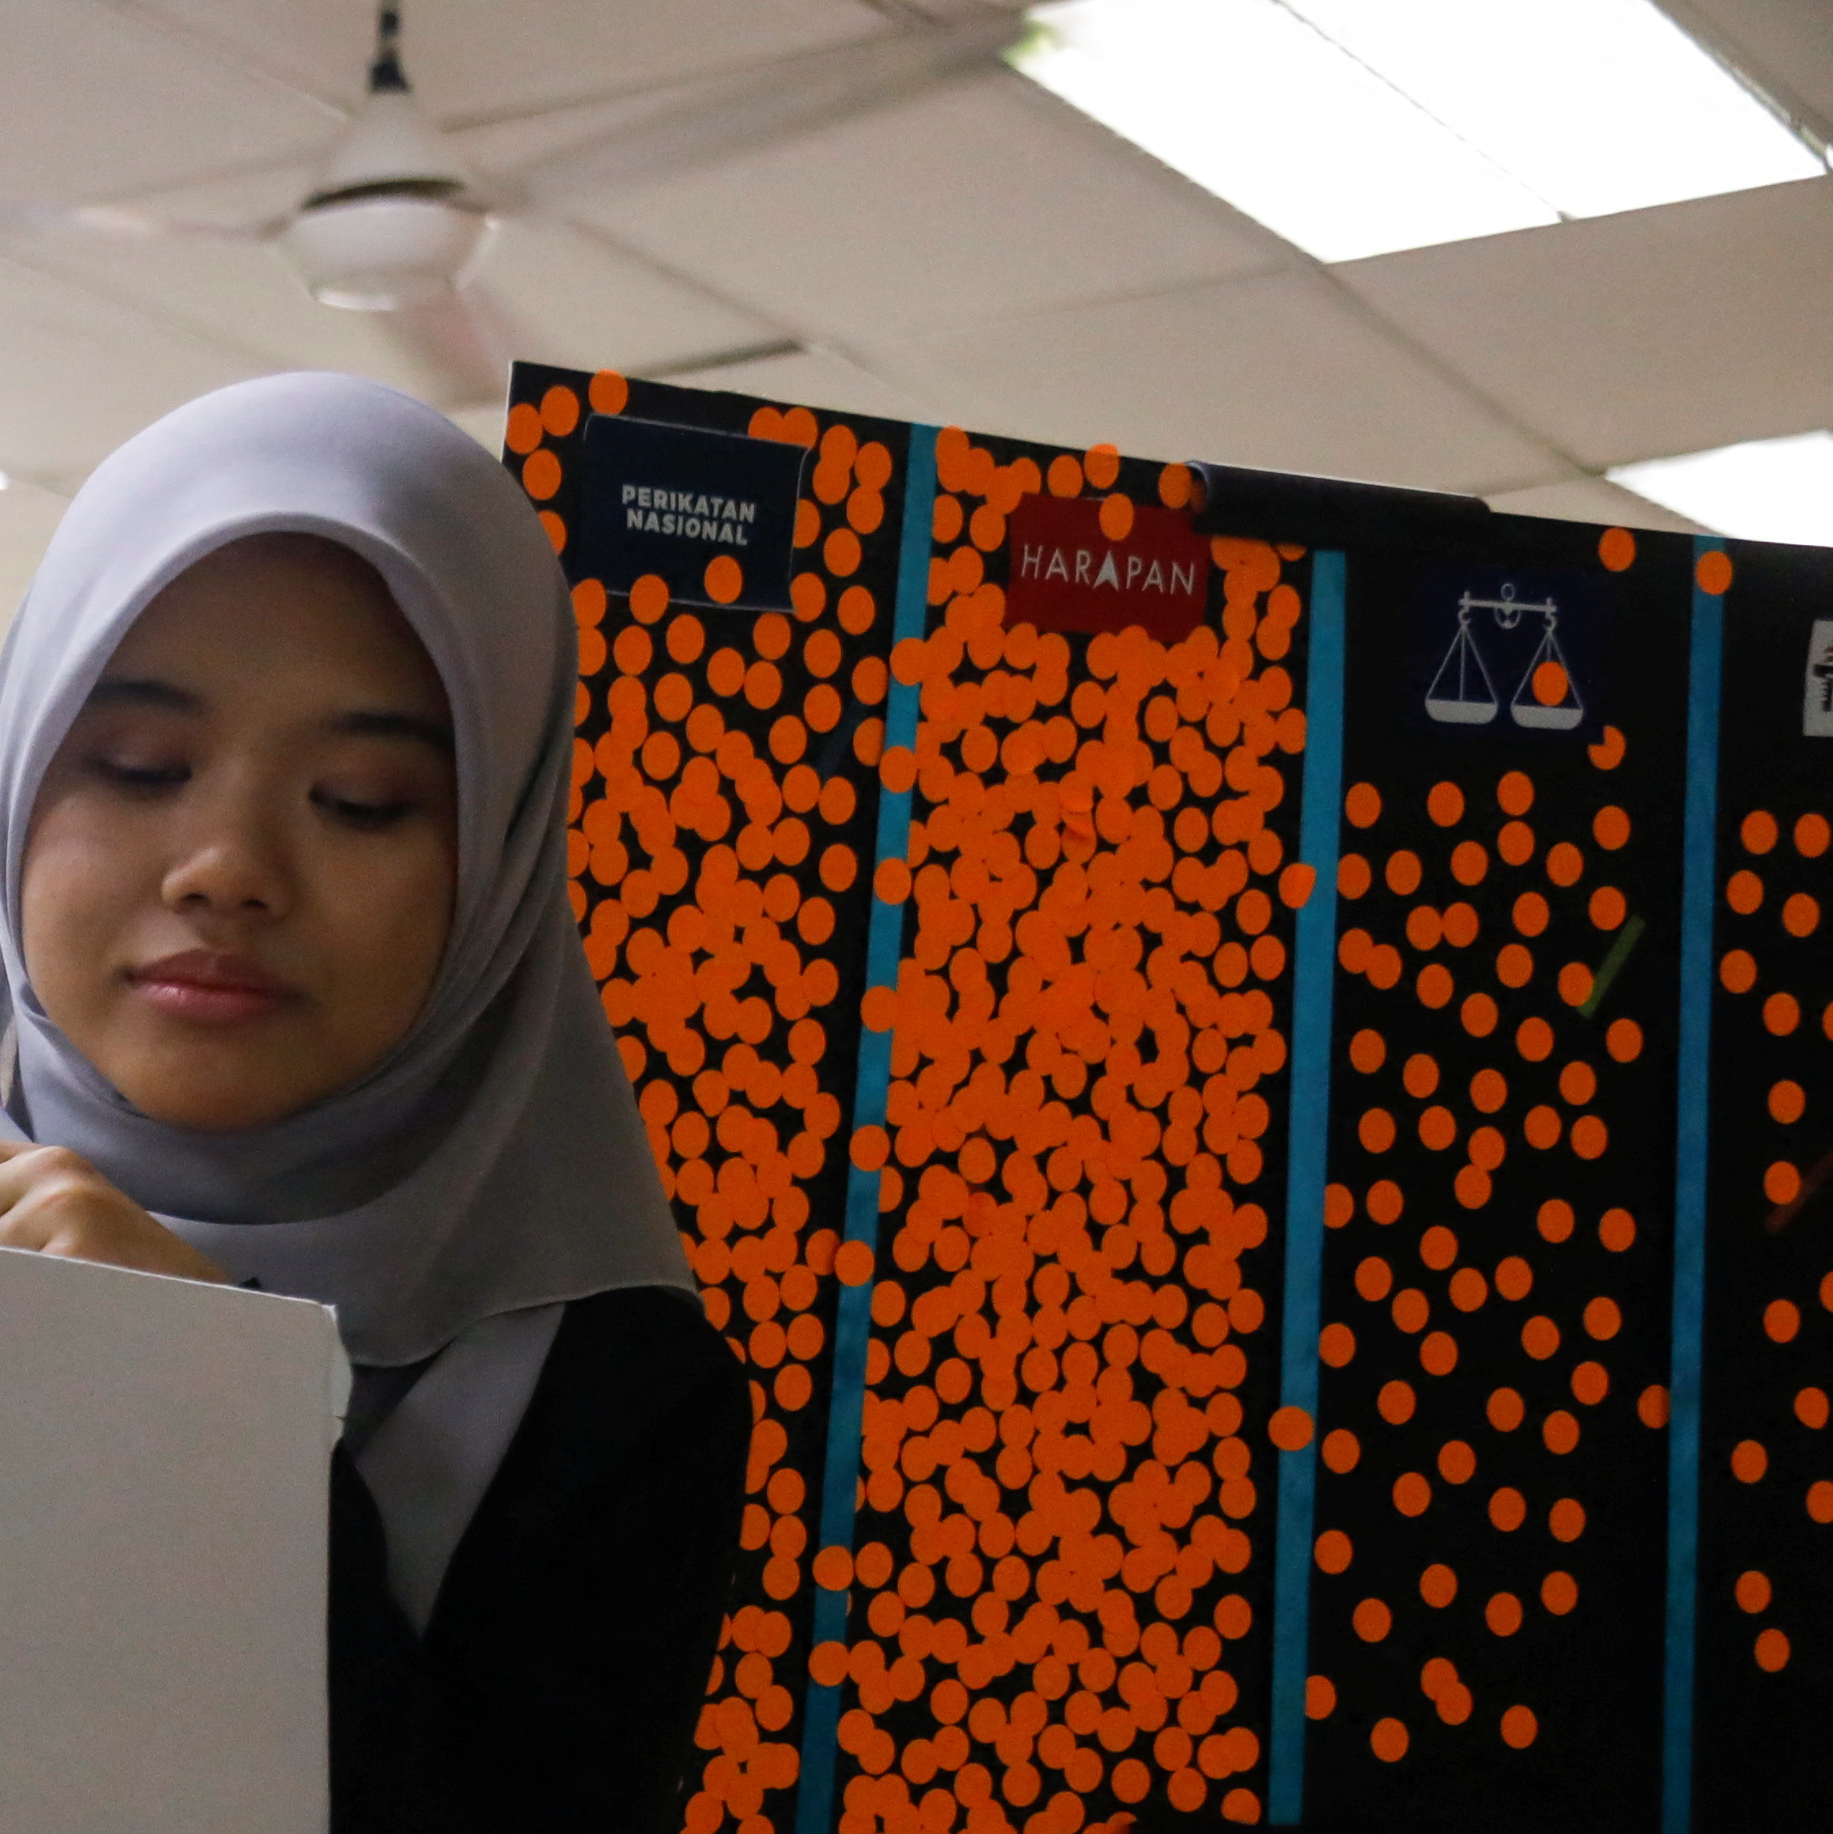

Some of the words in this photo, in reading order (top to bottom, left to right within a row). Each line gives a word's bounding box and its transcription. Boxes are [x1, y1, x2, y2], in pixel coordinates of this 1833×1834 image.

[621, 483, 757, 524] PERIKATAN
[626, 508, 749, 547] NASIONAL
[1021, 543, 1196, 596] HARAPAN
